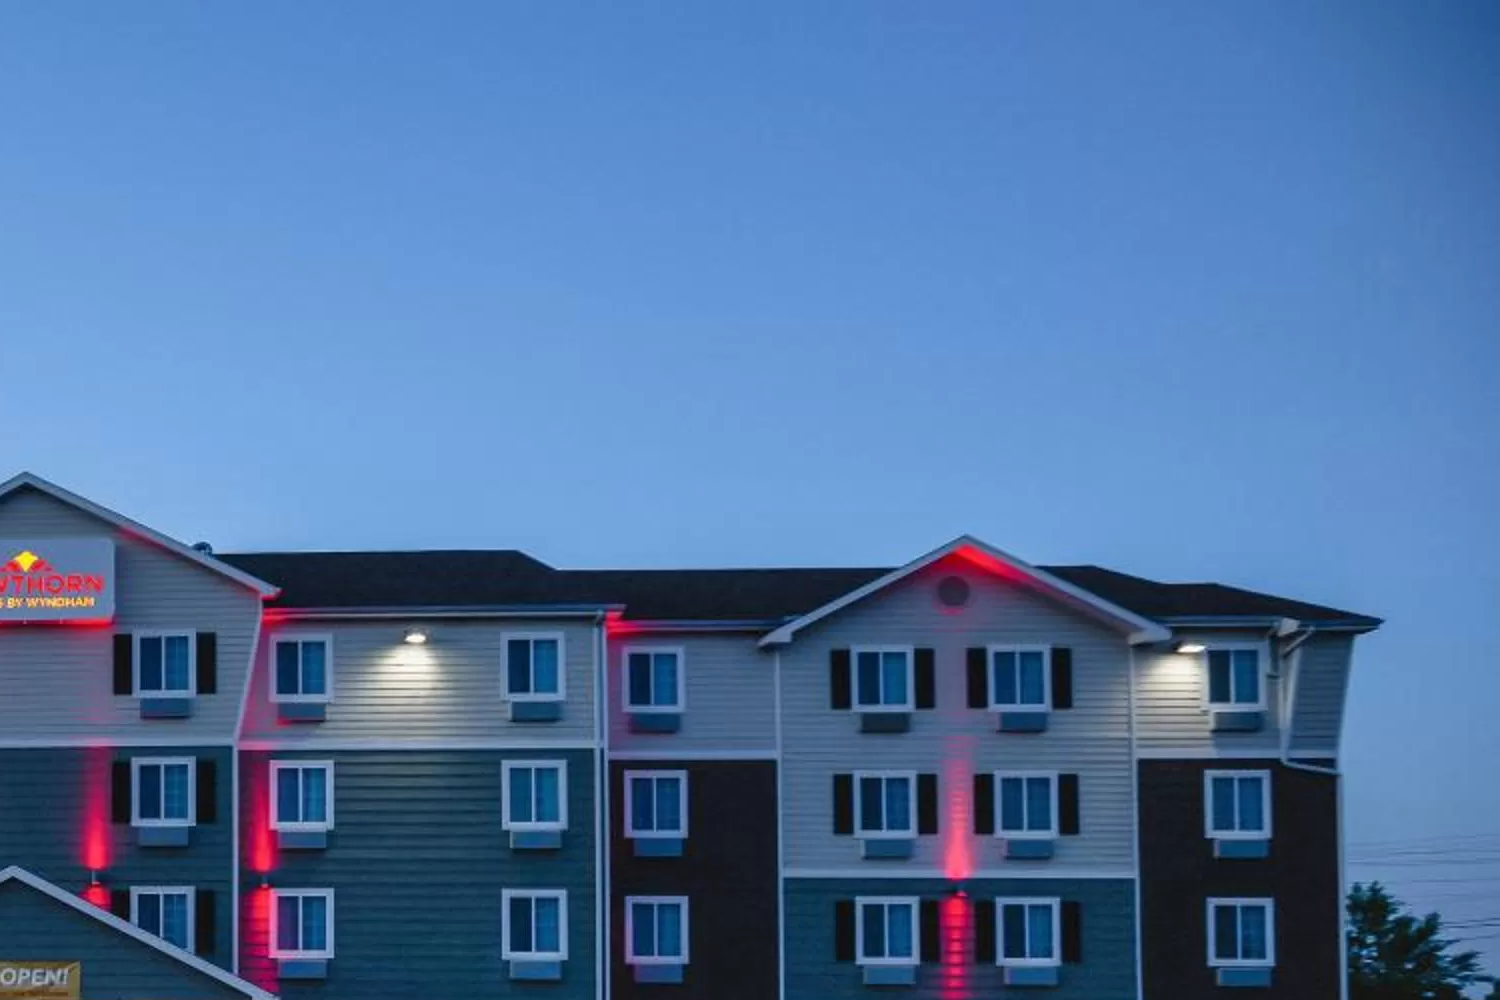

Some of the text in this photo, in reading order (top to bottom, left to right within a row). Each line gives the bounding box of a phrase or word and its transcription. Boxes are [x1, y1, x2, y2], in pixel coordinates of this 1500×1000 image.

[7, 597, 24, 609] BY
[26, 596, 95, 609] WYNDHAM
[0, 967, 69, 986] OPEN!
